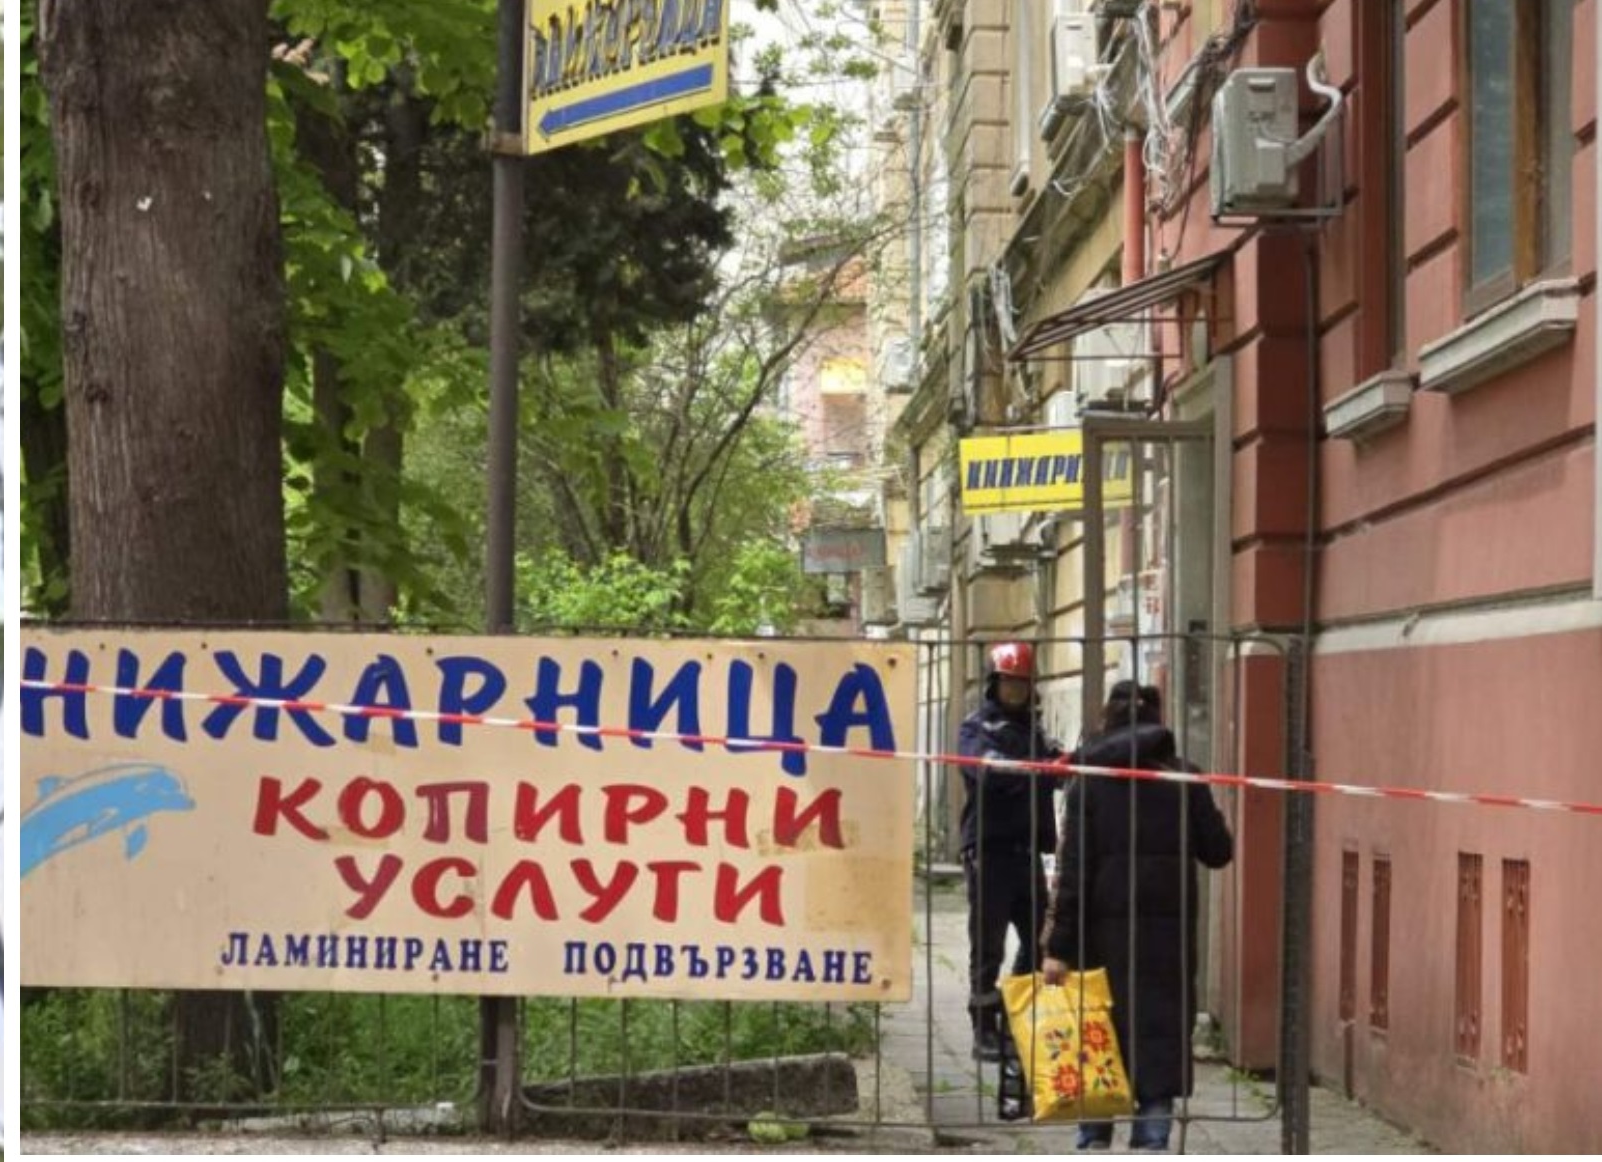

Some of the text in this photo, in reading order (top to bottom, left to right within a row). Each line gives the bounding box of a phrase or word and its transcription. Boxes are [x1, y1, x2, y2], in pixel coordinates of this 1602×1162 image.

[252, 775, 845, 849] КОПИРНИ
[334, 853, 786, 927] УСЛУГИ
[220, 931, 874, 985] ЛАМИНИРАНЕ ПОДВЪРЗВАНЕ
